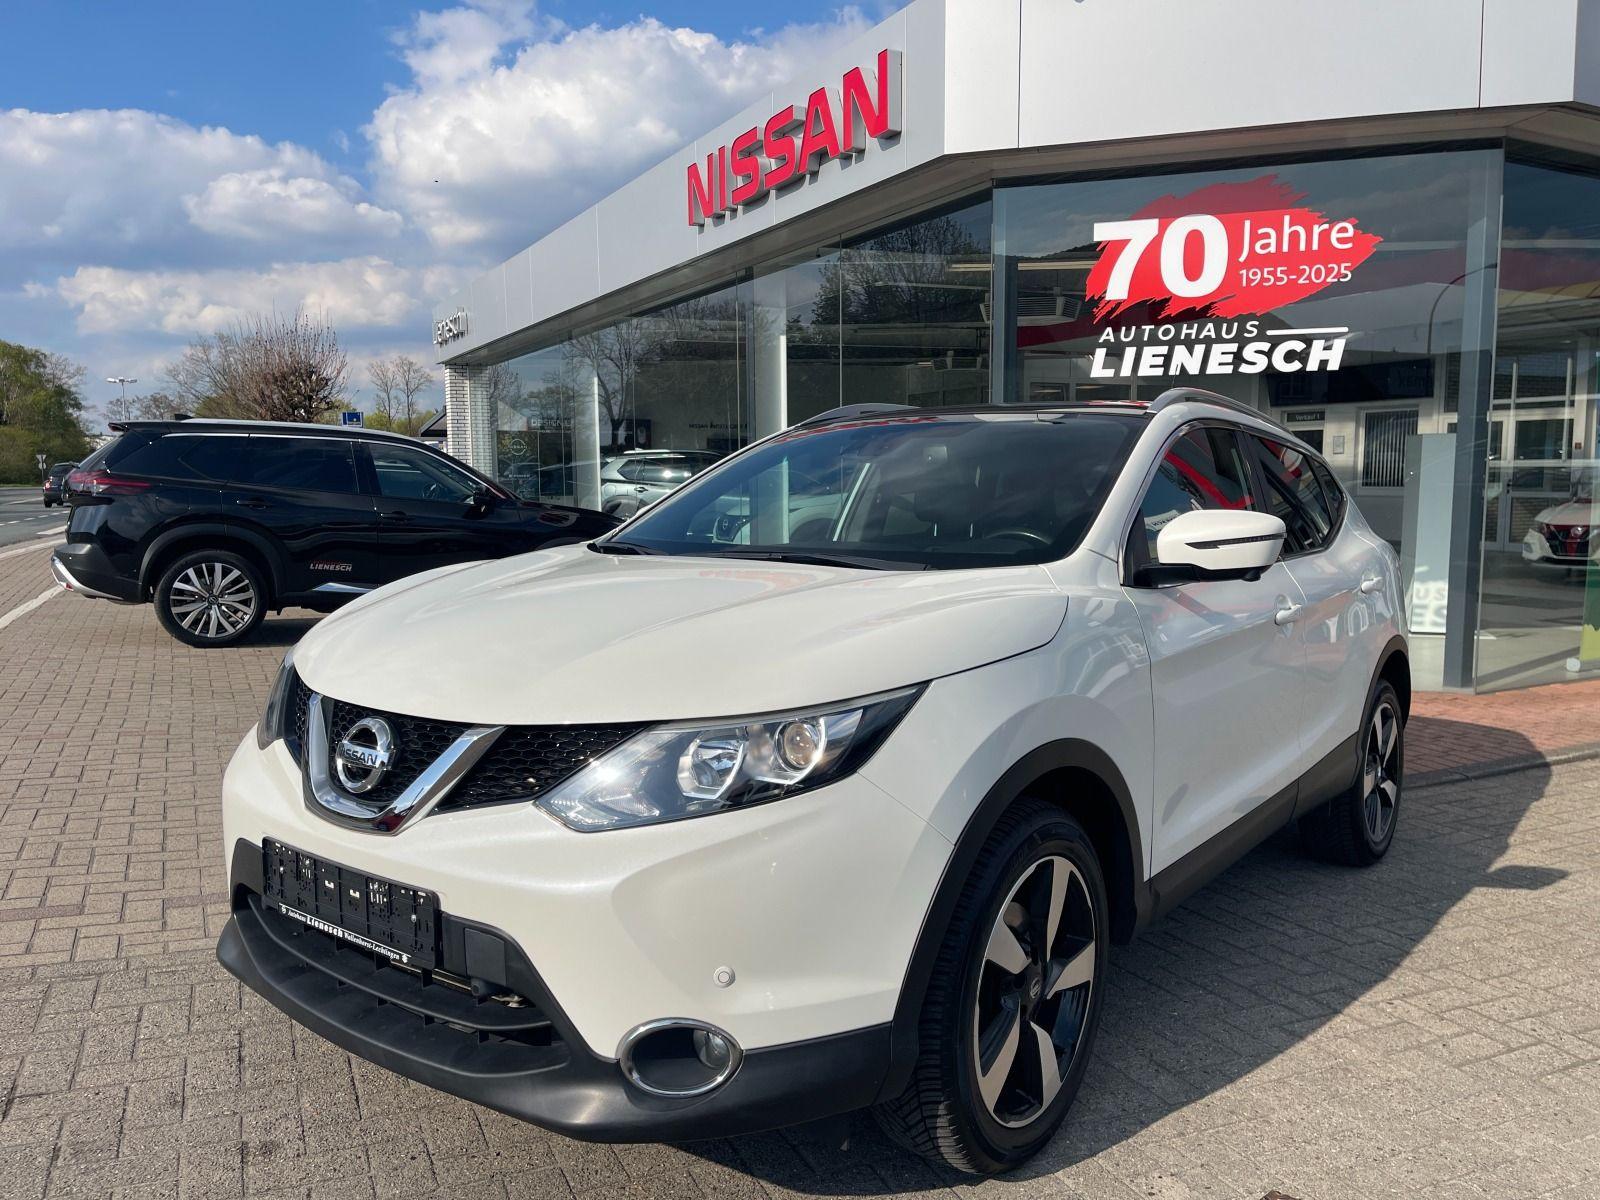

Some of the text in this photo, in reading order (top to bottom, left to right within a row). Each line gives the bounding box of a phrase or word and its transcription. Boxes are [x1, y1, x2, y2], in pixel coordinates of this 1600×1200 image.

[687, 48, 890, 227] NISSAN
[1238, 214, 1355, 263] Jahre
[1093, 213, 1229, 300] 70
[1238, 262, 1352, 288] 1955-2025
[1098, 320, 1260, 343] AUTOHAUS
[1089, 338, 1349, 379] LIENESCH
[310, 563, 352, 571] LIENESCH
[306, 915, 343, 938] Lienesch
